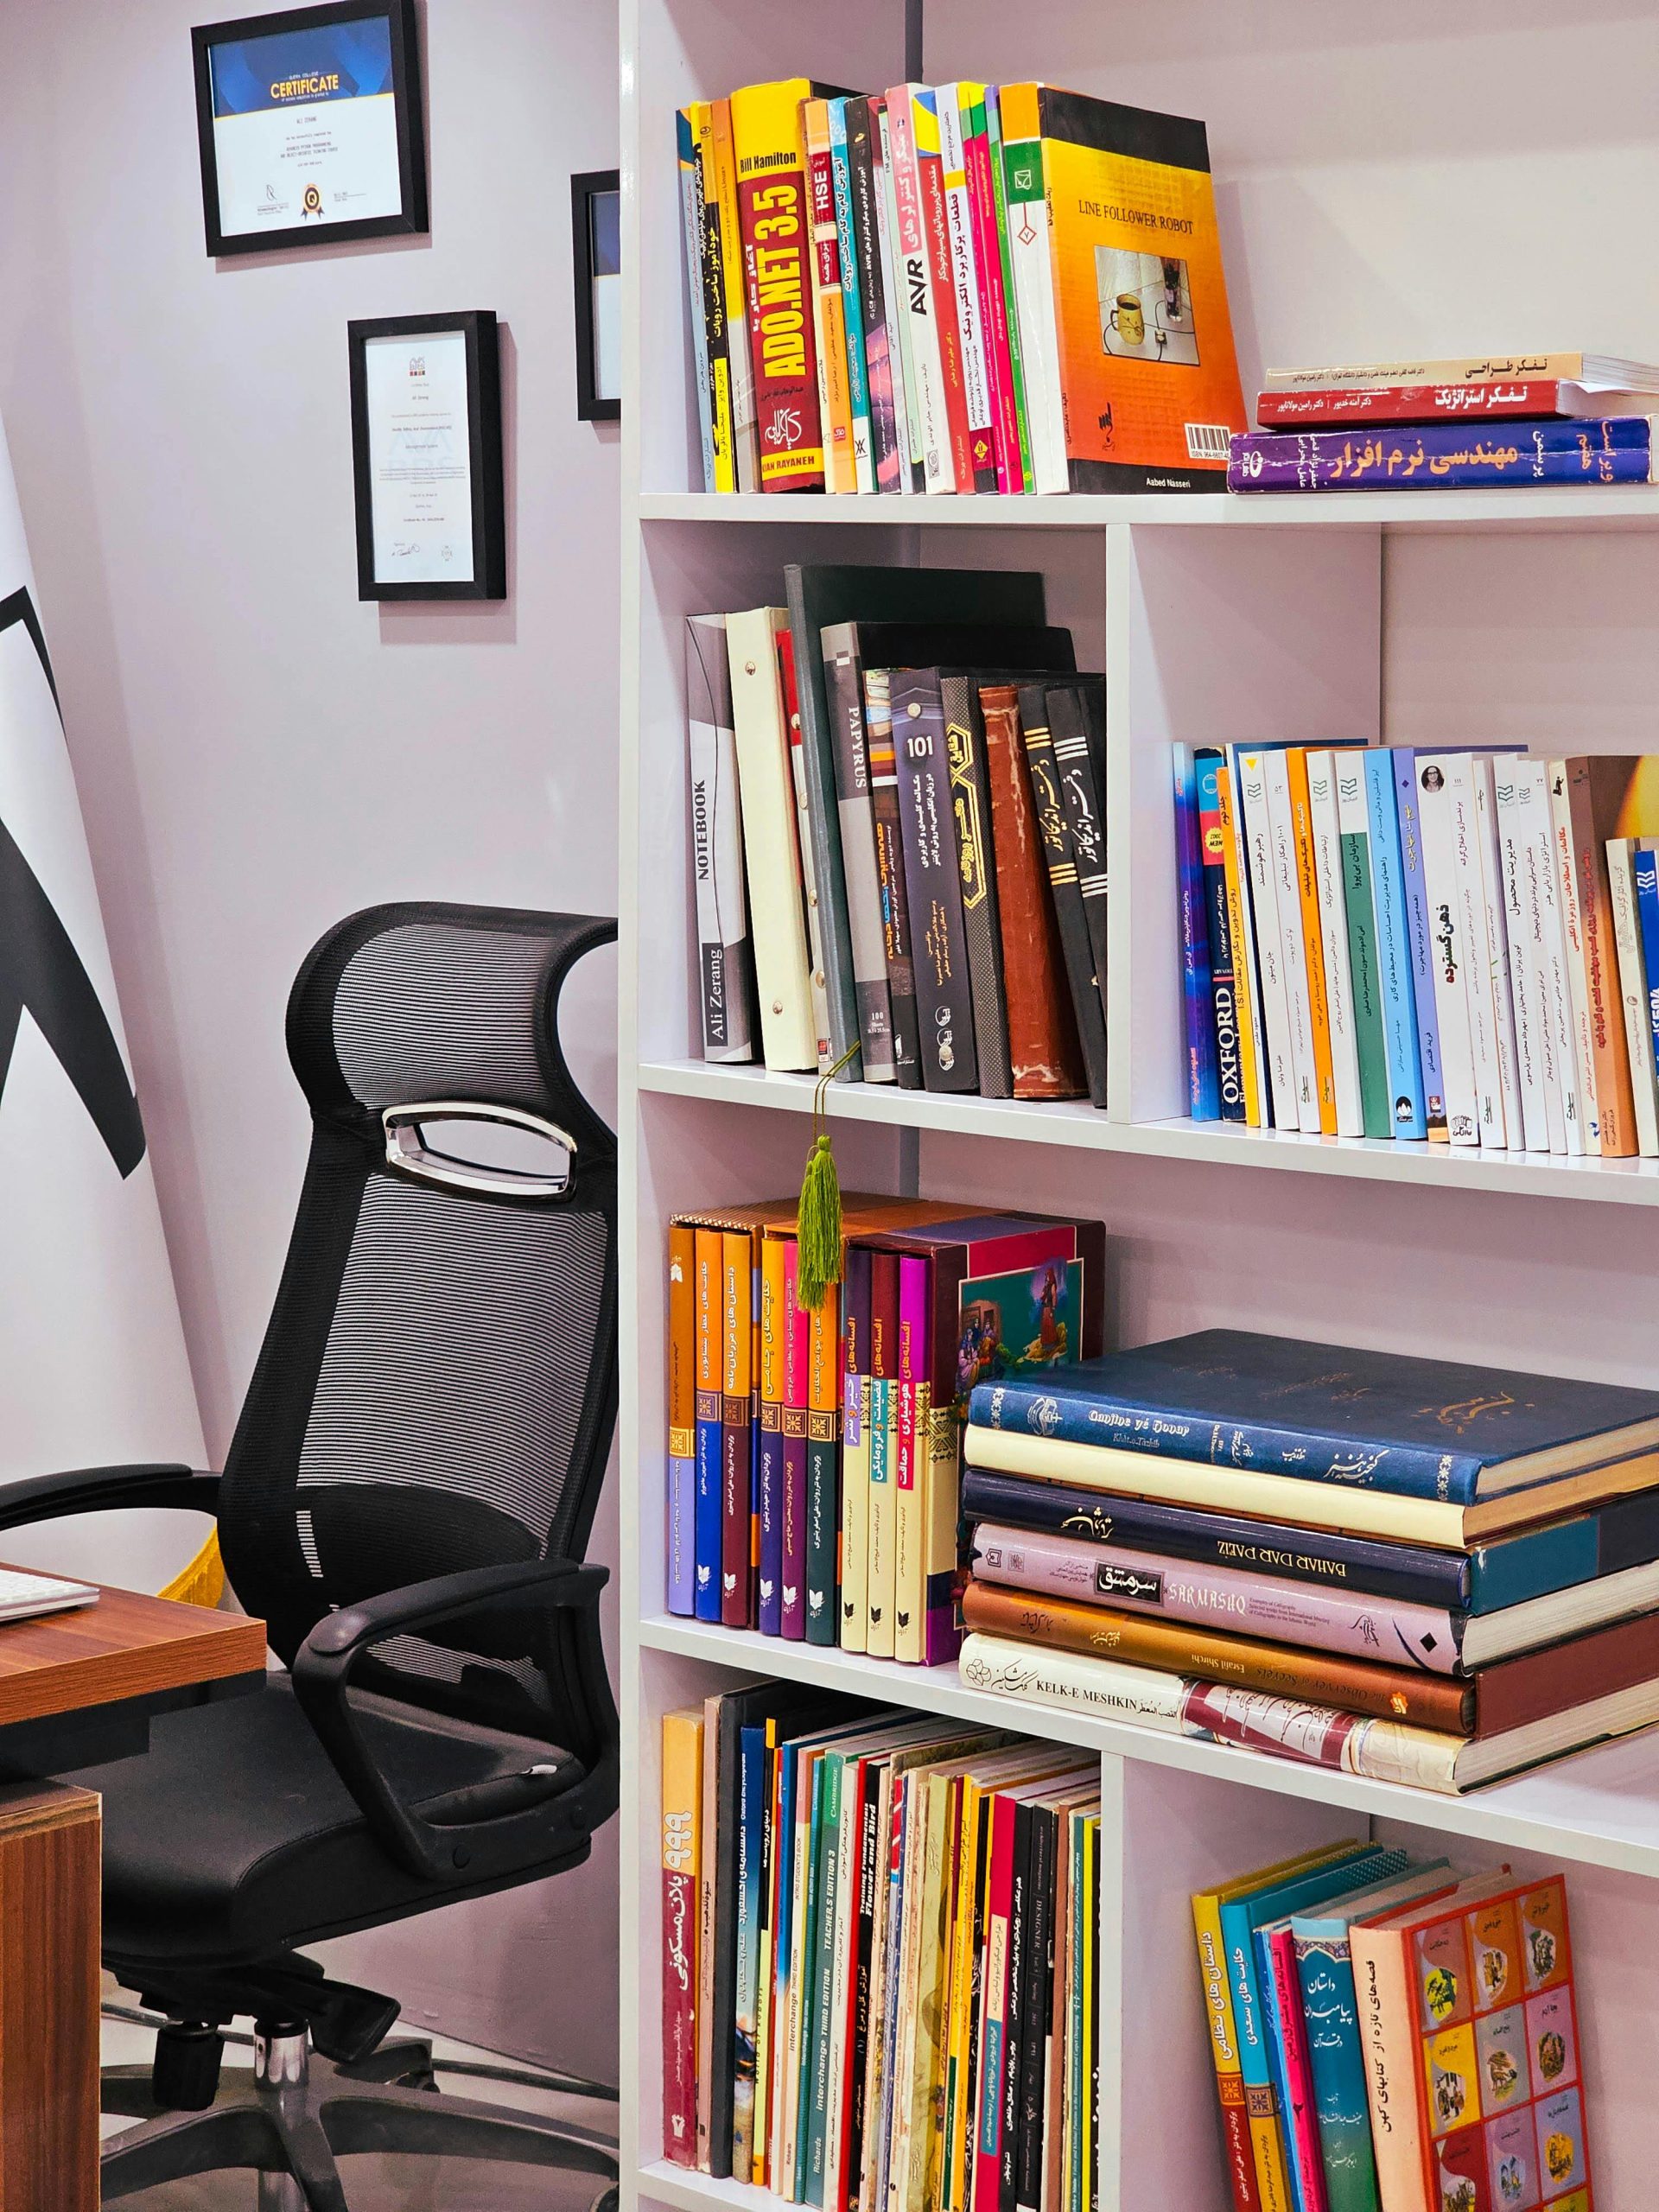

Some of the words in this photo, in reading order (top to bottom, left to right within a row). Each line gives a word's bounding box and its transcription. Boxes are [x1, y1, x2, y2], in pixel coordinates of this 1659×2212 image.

[270, 74, 339, 99] CERTIFICATE
[741, 157, 753, 174] Bill
[753, 151, 796, 171] Hamilton
[835, 157, 846, 189] آموزش
[814, 170, 828, 210] HSE
[753, 184, 799, 240] 3.5
[1078, 200, 1102, 218] LINE
[1103, 205, 1158, 228] FOLLOWER
[1160, 218, 1194, 235] ROBOT
[949, 194, 961, 232] قطعات
[960, 283, 973, 340] الکترونیک
[906, 258, 928, 316] AVR
[756, 246, 805, 378] ADO.NET
[1465, 361, 1513, 378] طراحی
[1516, 358, 1548, 376] تفکر
[1434, 388, 1484, 410] استراتژیک
[1485, 386, 1528, 409] تفکر
[777, 455, 814, 469] RAYANEH
[1330, 439, 1382, 478] افزار
[1388, 439, 1425, 476] نرم
[1429, 441, 1518, 474] مهندسی
[1146, 477, 1166, 486] Aabed
[1167, 479, 1191, 489] Nasseri
[848, 707, 867, 789] PAPYRUS
[907, 735, 934, 759] 101
[912, 774, 921, 804] مکالمه
[926, 782, 935, 798] زبان
[1031, 760, 1061, 810] دفتر
[1063, 769, 1094, 819] دفتر
[915, 804, 927, 831] کلیدی
[927, 798, 938, 824] انگلیسی
[954, 798, 972, 842] دفتر
[694, 779, 709, 880] NOTEBOOK
[931, 832, 939, 849] روش
[1255, 833, 1263, 853] رهبر
[1558, 827, 1567, 854] مکالمات
[918, 838, 929, 868] کاربردی
[961, 842, 975, 883] روزنامه
[1279, 839, 1288, 861] راهکار
[1349, 833, 1359, 863] سازمان
[1506, 838, 1516, 876] مدیریت
[1526, 847, 1535, 867] داستان
[1539, 832, 1550, 864] استراتژی
[1255, 853, 1266, 887] هوشمند
[1323, 861, 1332, 877] داخلی
[1542, 865, 1553, 893] بازاریابی
[1561, 861, 1572, 897] اصطلاحات
[1325, 878, 1334, 908] استراتژیک
[1509, 879, 1521, 916] محصول
[1546, 894, 1554, 906] هنر
[1380, 856, 1389, 882] راهنمای
[1390, 986, 1399, 1001] کاری
[1436, 904, 1454, 934] ذهن
[1568, 925, 1580, 952] انگلیسی
[1437, 934, 1458, 983] گسترده
[709, 950, 723, 1007] Zerang
[711, 1014, 724, 1040] Ali
[871, 1012, 884, 1020] 100
[1215, 988, 1240, 1104] OXFORD
[727, 1267, 737, 1306] داستان
[763, 1279, 774, 1316] حکایت
[727, 1306, 737, 1328] های
[763, 1318, 774, 1344] های
[728, 1332, 738, 1369] مرزبان
[763, 1348, 775, 1395] جامی
[847, 1378, 858, 1409] خیر
[872, 1381, 883, 1421] فضیلت
[899, 1382, 912, 1435] هوشیاری
[845, 1419, 858, 1443] شر
[874, 1431, 885, 1481] فرومایگی
[899, 1446, 908, 1485] حماقت
[1259, 1548, 1294, 1567] DAR
[1296, 1557, 1347, 1577] BAHAR
[1098, 1567, 1158, 1596] سرمشق
[1191, 1653, 1219, 1668] Shirchi
[1036, 1681, 1079, 1699] KELK-E
[1083, 1689, 1138, 1711] MESHKIN
[830, 1767, 838, 1818] CAMBRIDGE
[828, 1849, 836, 1858] 3
[827, 1862, 836, 1898] EDITION
[865, 1870, 874, 1917] Flower
[667, 1916, 690, 1991] مسکونی
[1201, 1930, 1221, 1981] داستان
[1232, 1946, 1251, 1980] حکایت
[1209, 1983, 1225, 2012] های
[1237, 1981, 1253, 2003] های
[1307, 1973, 1336, 1994] داستان
[821, 2005, 830, 2037] THIRD
[1213, 2013, 1234, 2061] نظامی
[1243, 2005, 1258, 2046] سعدی
[816, 2039, 827, 2111] interchange
[813, 2137, 822, 2175] Richards
